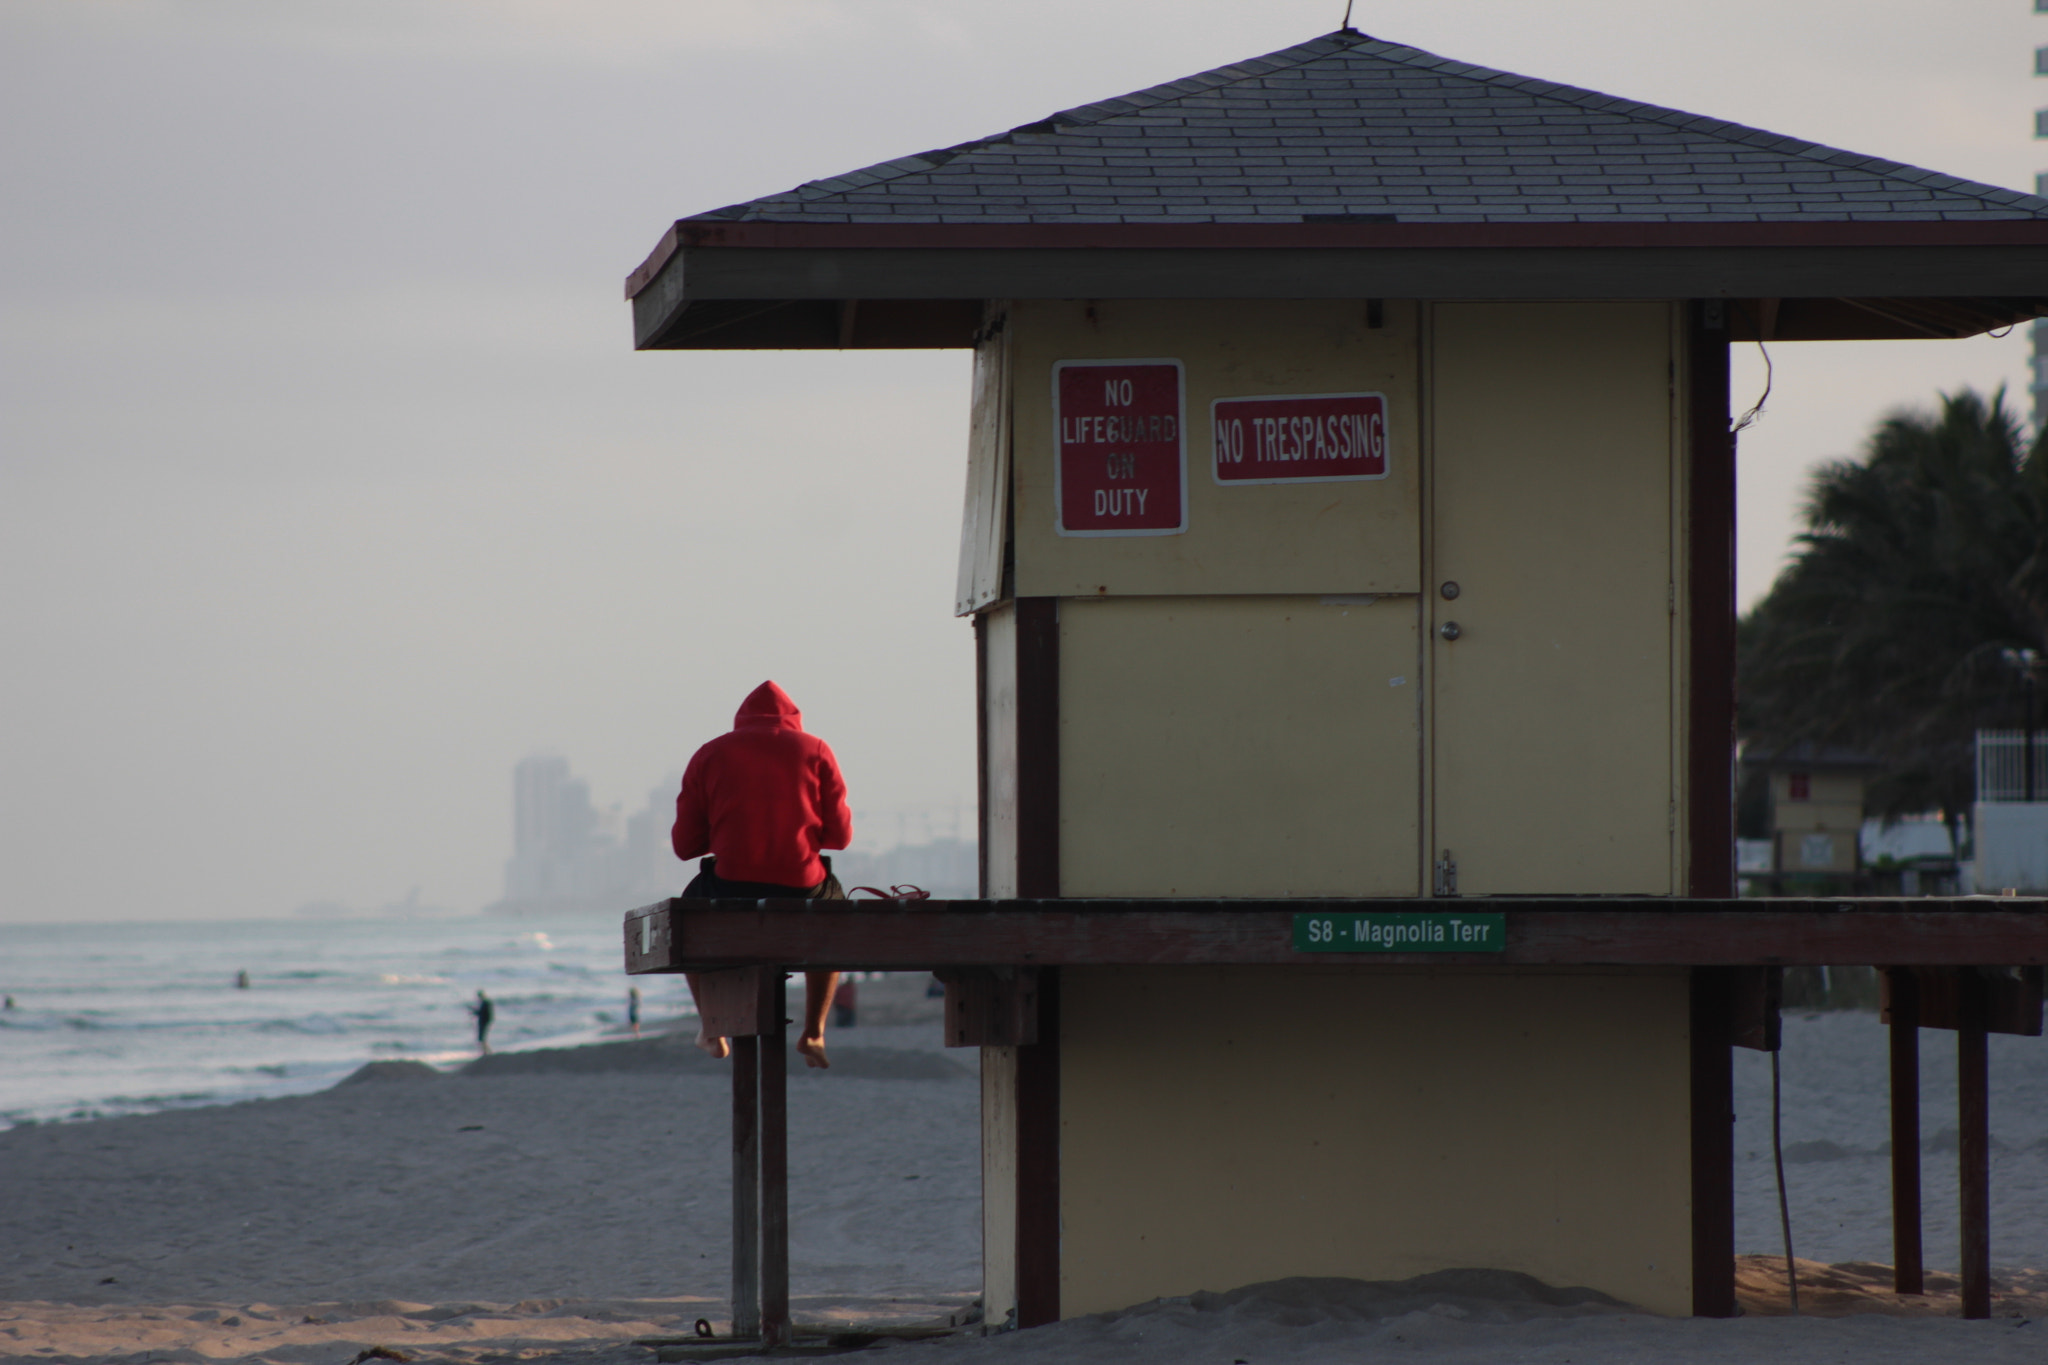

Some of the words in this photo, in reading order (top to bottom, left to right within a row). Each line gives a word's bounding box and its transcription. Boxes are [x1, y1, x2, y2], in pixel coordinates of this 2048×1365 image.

[1104, 379, 1133, 406] NO
[1063, 415, 1177, 444] LIFEGUARD
[1217, 418, 1244, 463] NO
[1253, 413, 1382, 462] TRESPASSING
[1107, 453, 1135, 479] ON
[1094, 488, 1149, 516] DUTY
[1308, 919, 1333, 942] S8
[1354, 919, 1445, 948] Magnolia
[1449, 919, 1490, 942] Terr
